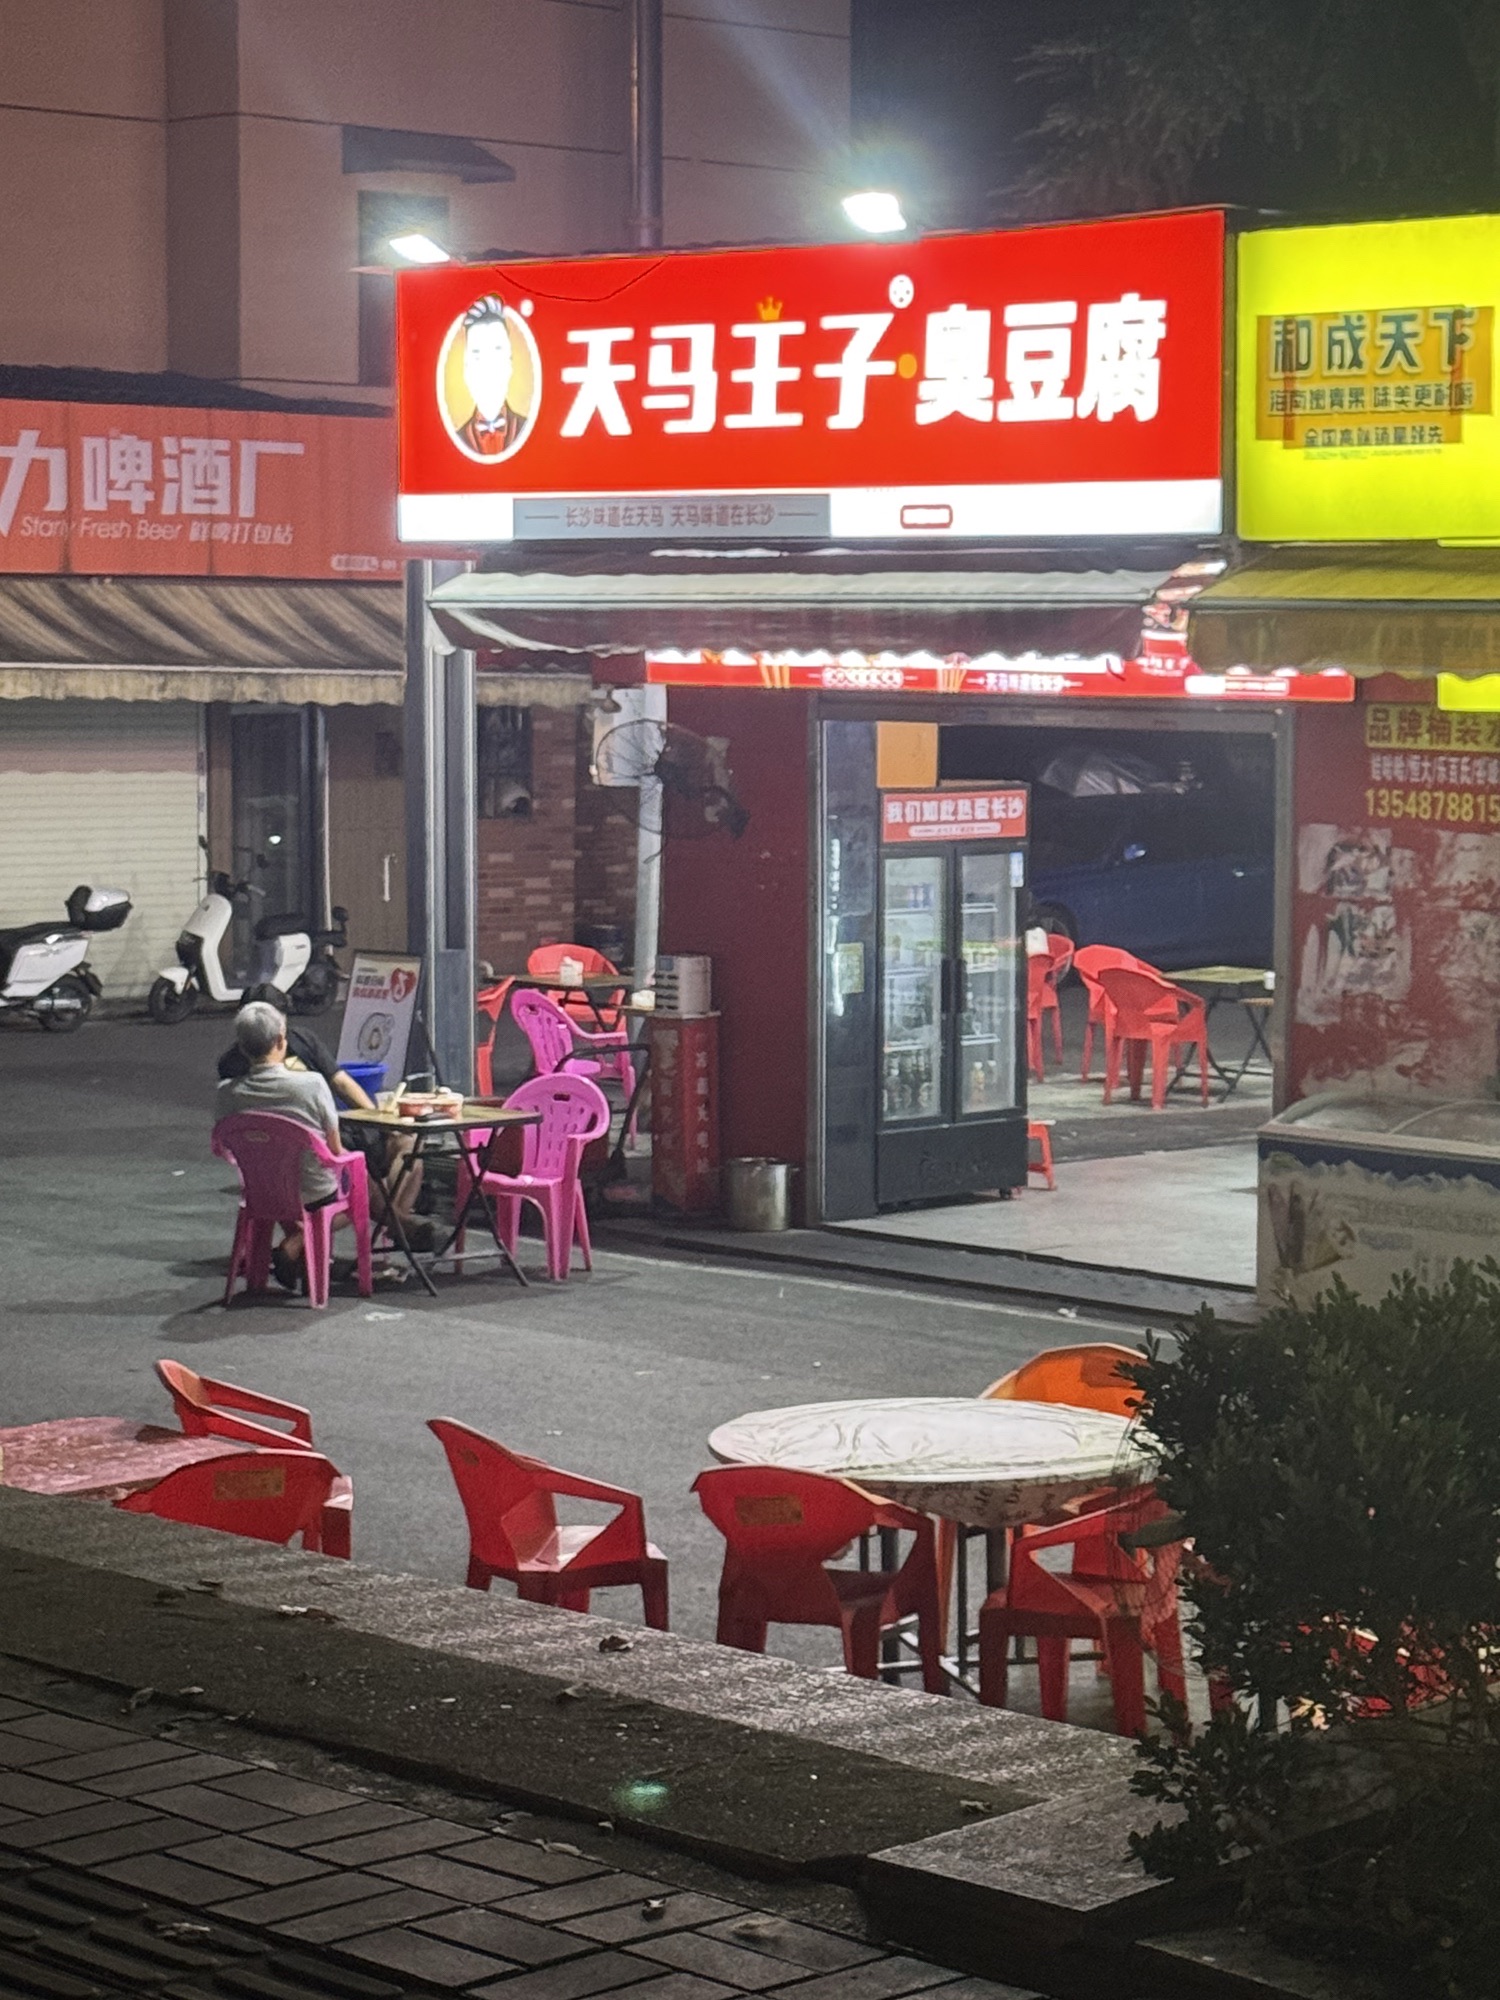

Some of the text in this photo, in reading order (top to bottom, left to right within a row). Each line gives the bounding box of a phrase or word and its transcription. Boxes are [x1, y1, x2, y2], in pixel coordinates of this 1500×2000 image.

[1270, 307, 1476, 376] 和成天下
[79, 518, 131, 538] Fresh
[136, 521, 183, 541] Beer
